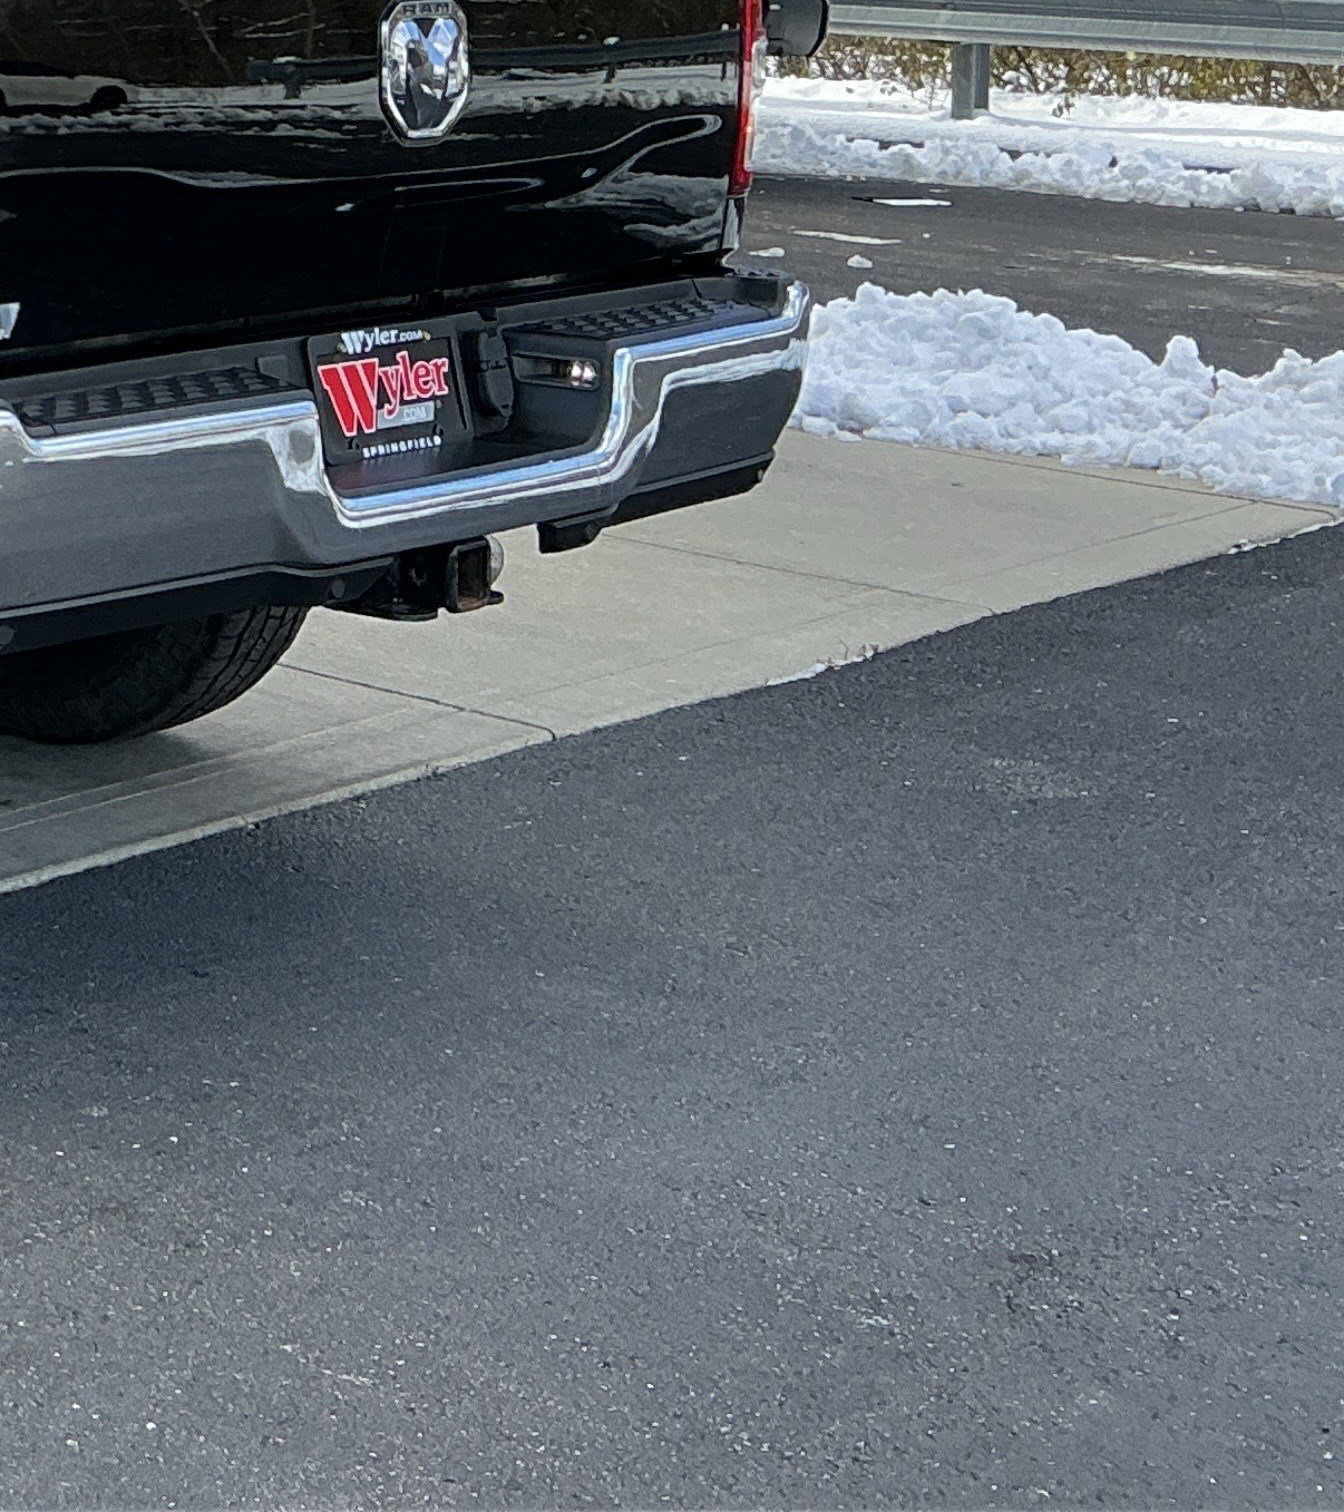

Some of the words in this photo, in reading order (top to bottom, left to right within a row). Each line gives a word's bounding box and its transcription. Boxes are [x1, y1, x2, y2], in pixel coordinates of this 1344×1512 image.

[401, 2, 450, 15] RAM
[317, 350, 449, 437] Wyler
[363, 435, 442, 459] SPRINGFIELD
